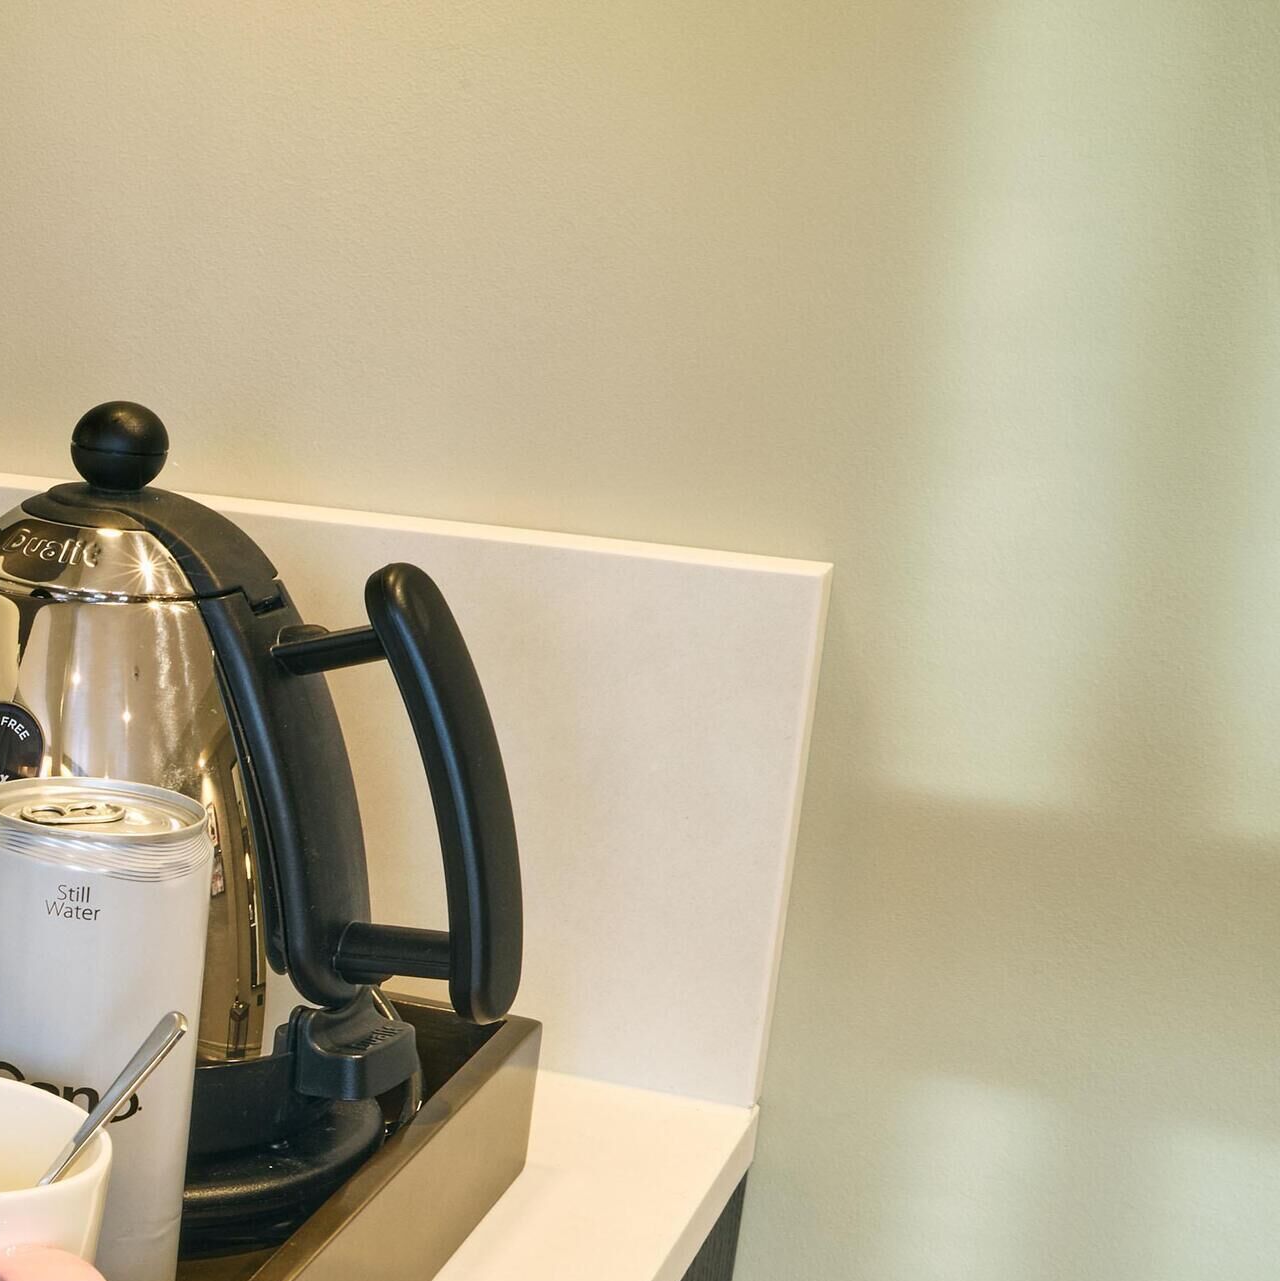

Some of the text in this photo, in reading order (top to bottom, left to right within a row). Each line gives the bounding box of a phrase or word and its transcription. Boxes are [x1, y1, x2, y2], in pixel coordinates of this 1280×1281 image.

[0, 716, 30, 741] FREE
[57, 884, 91, 904] Still
[45, 899, 102, 921] Water
